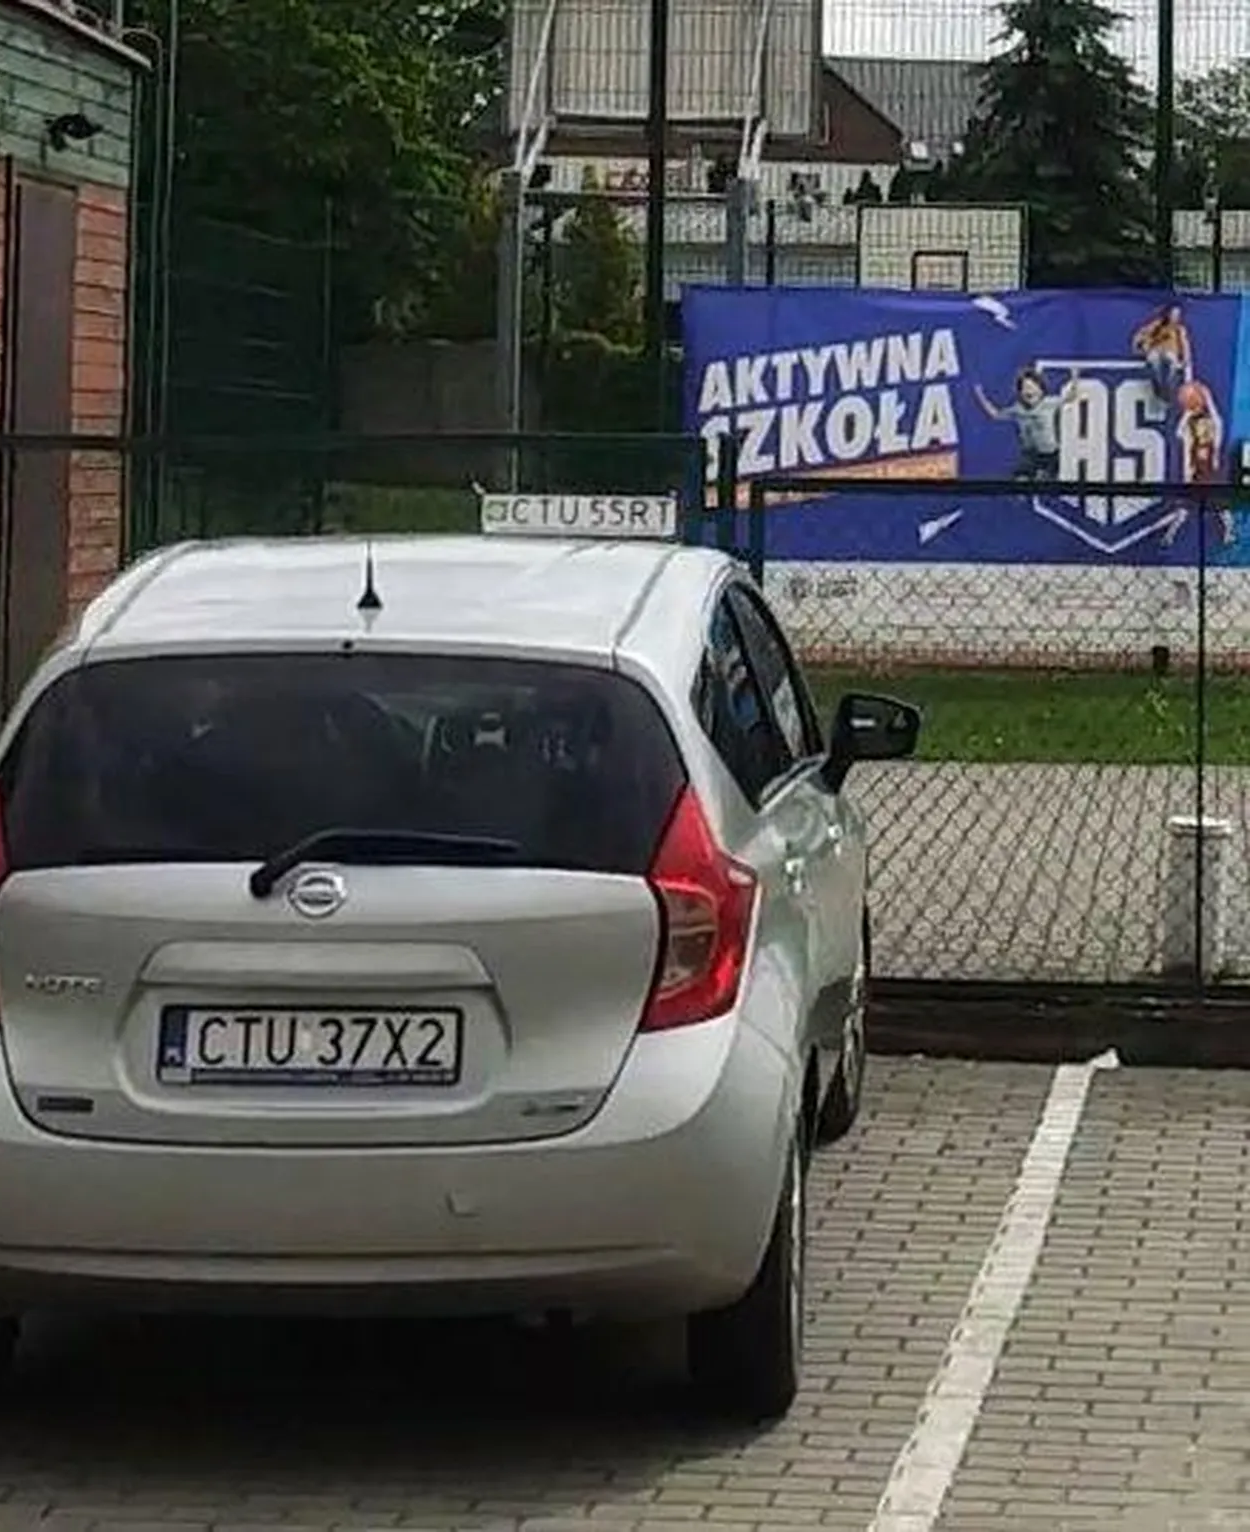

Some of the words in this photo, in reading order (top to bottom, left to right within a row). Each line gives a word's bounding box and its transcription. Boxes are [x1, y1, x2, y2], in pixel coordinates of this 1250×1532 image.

[698, 328, 960, 413] AKTYWNA
[1057, 377, 1166, 526] AS
[198, 1016, 297, 1066] CTU
[316, 1017, 445, 1067] 37X2
